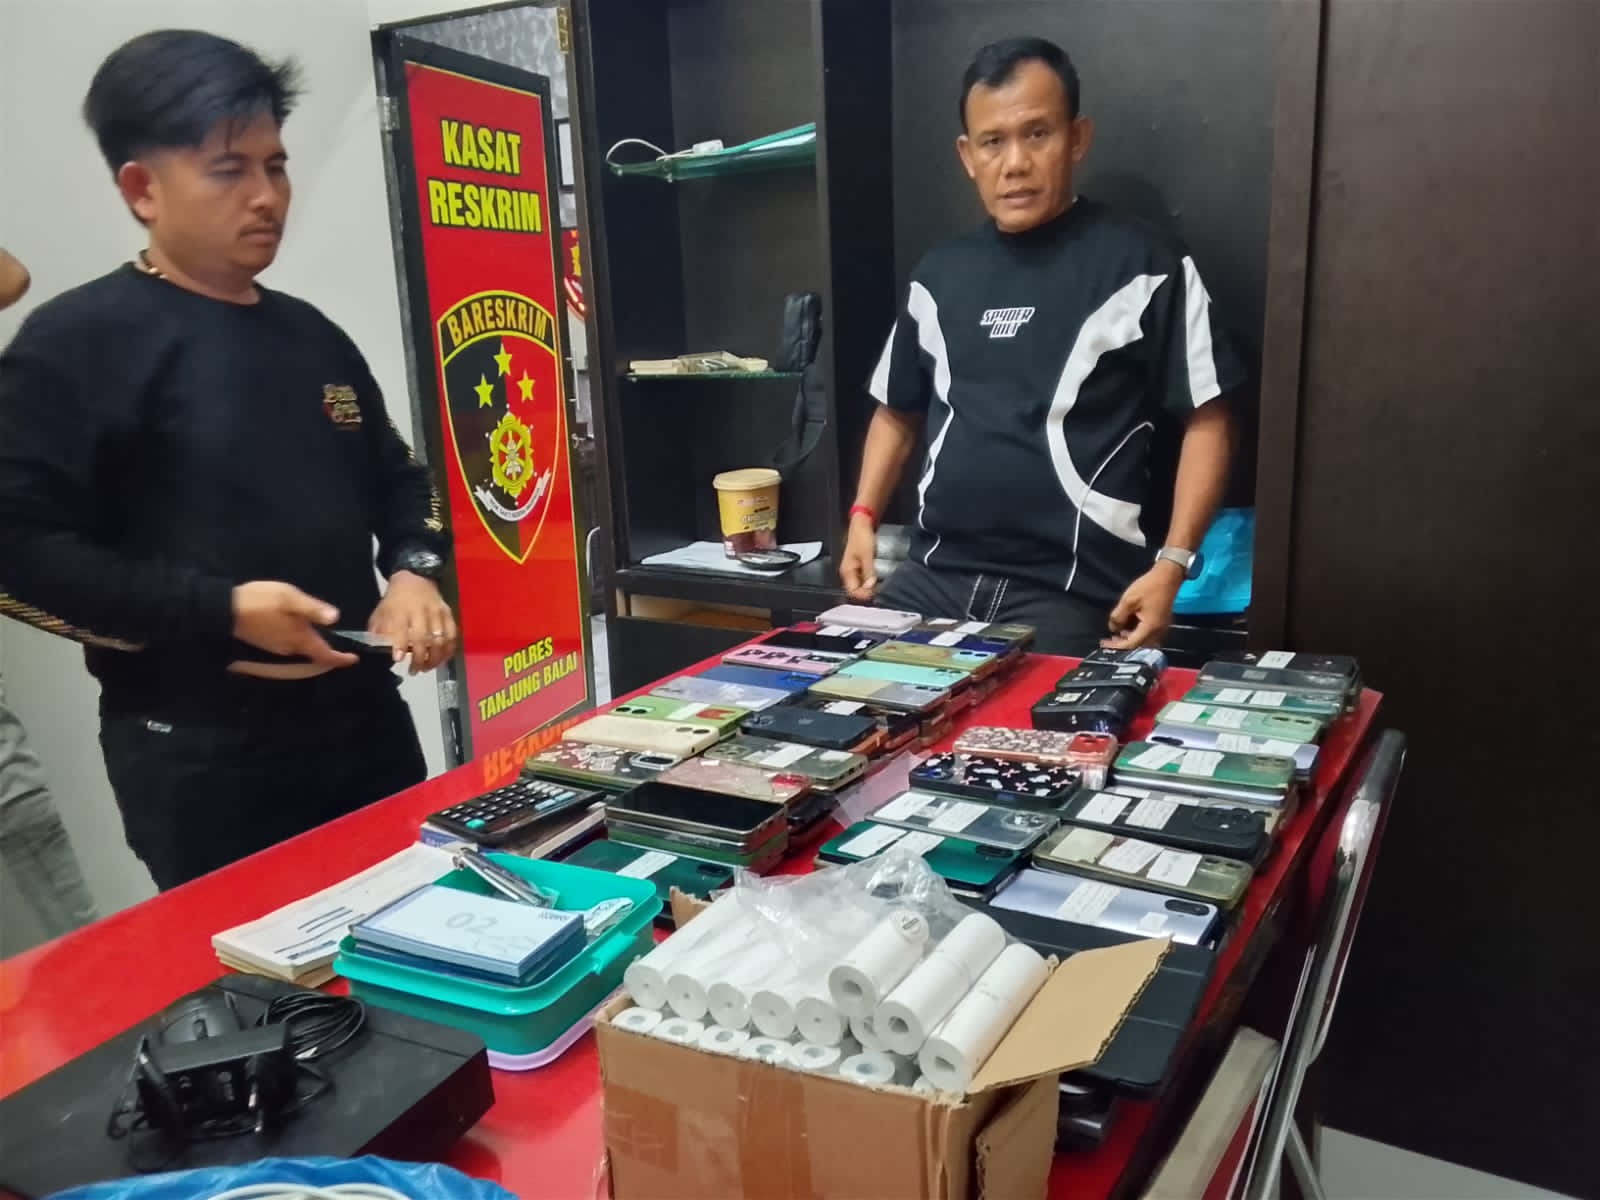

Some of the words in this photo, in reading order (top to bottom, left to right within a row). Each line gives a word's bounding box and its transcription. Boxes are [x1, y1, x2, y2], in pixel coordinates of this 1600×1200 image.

[441, 119, 521, 175] KASAT
[428, 179, 542, 232] RESKRIM
[446, 298, 548, 347] BARESKRIM
[504, 636, 553, 678] POLRES
[478, 671, 540, 721] TANJUNG
[543, 651, 577, 687] BALAI
